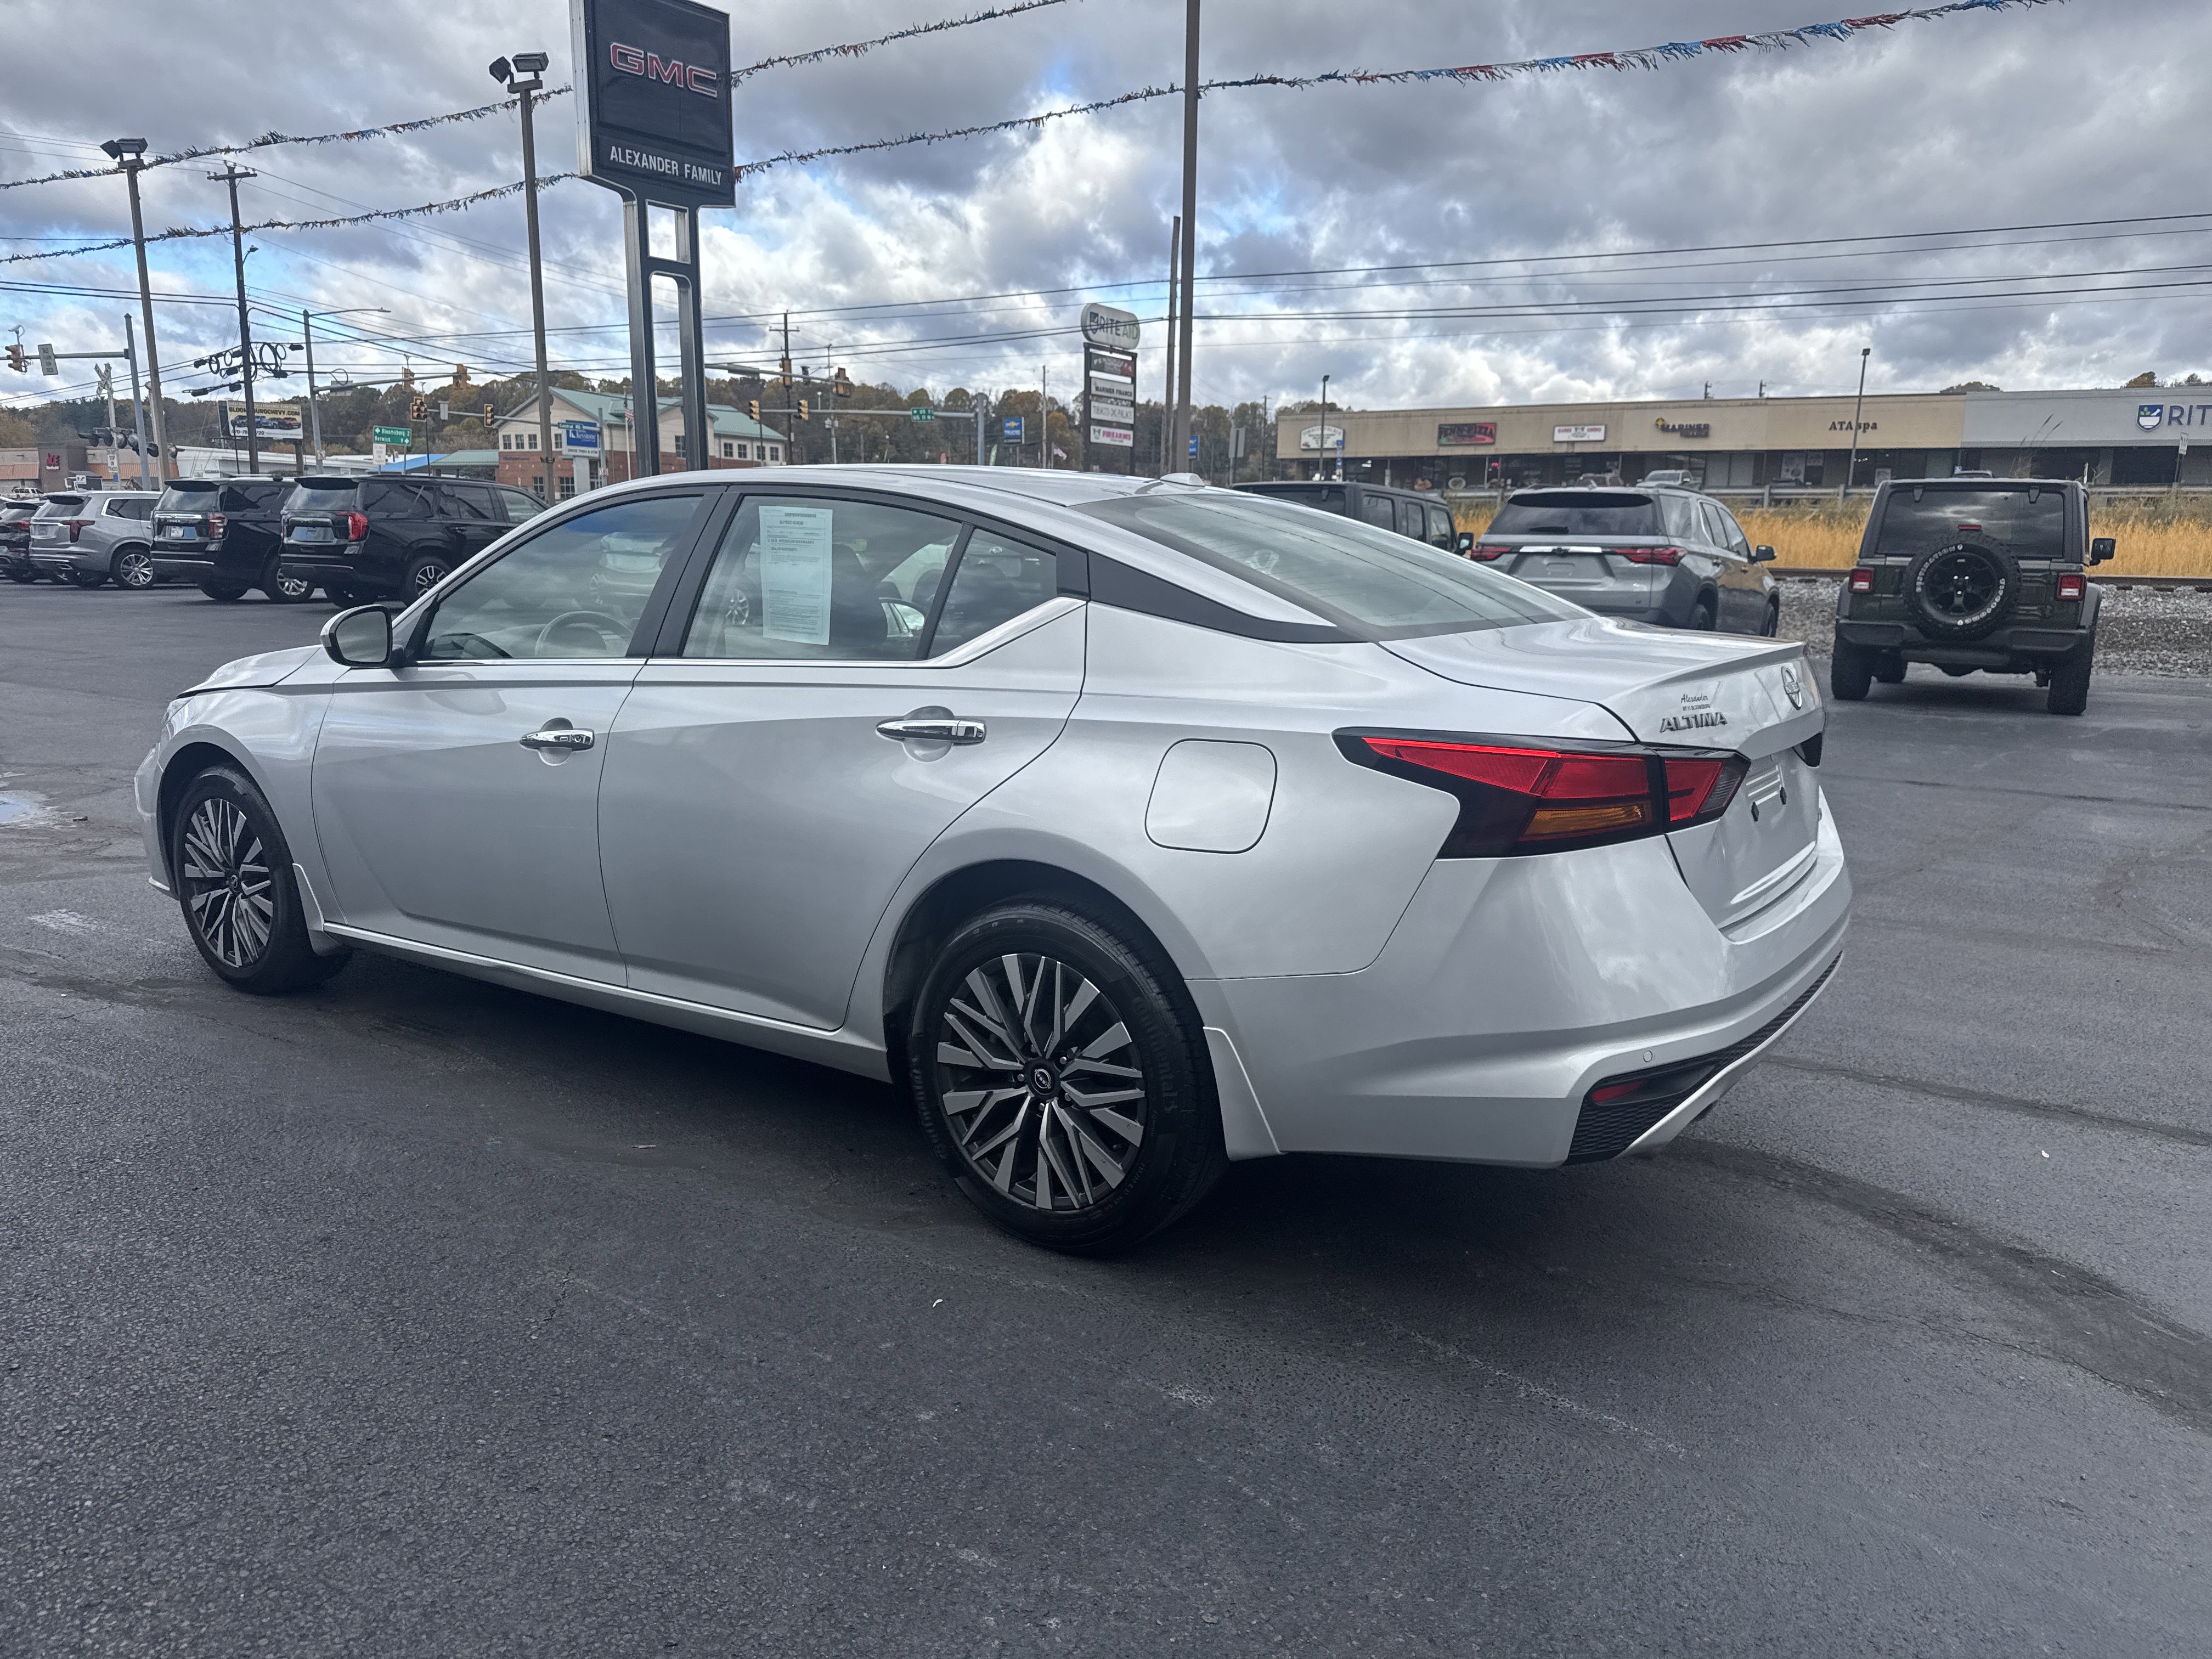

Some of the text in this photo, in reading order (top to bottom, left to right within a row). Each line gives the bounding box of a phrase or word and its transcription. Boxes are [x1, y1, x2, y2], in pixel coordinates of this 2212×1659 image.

[610, 42, 717, 98] GMC
[610, 146, 721, 185] ALEXANDER FAMILY
[1099, 315, 1138, 340] RITE AID
[381, 428, 405, 437] Bloomsburg
[1829, 421, 1853, 431] ATA
[47, 455, 60, 465] ACE
[1681, 694, 1708, 703] Alexander
[1660, 712, 1728, 733] ALTIMA
